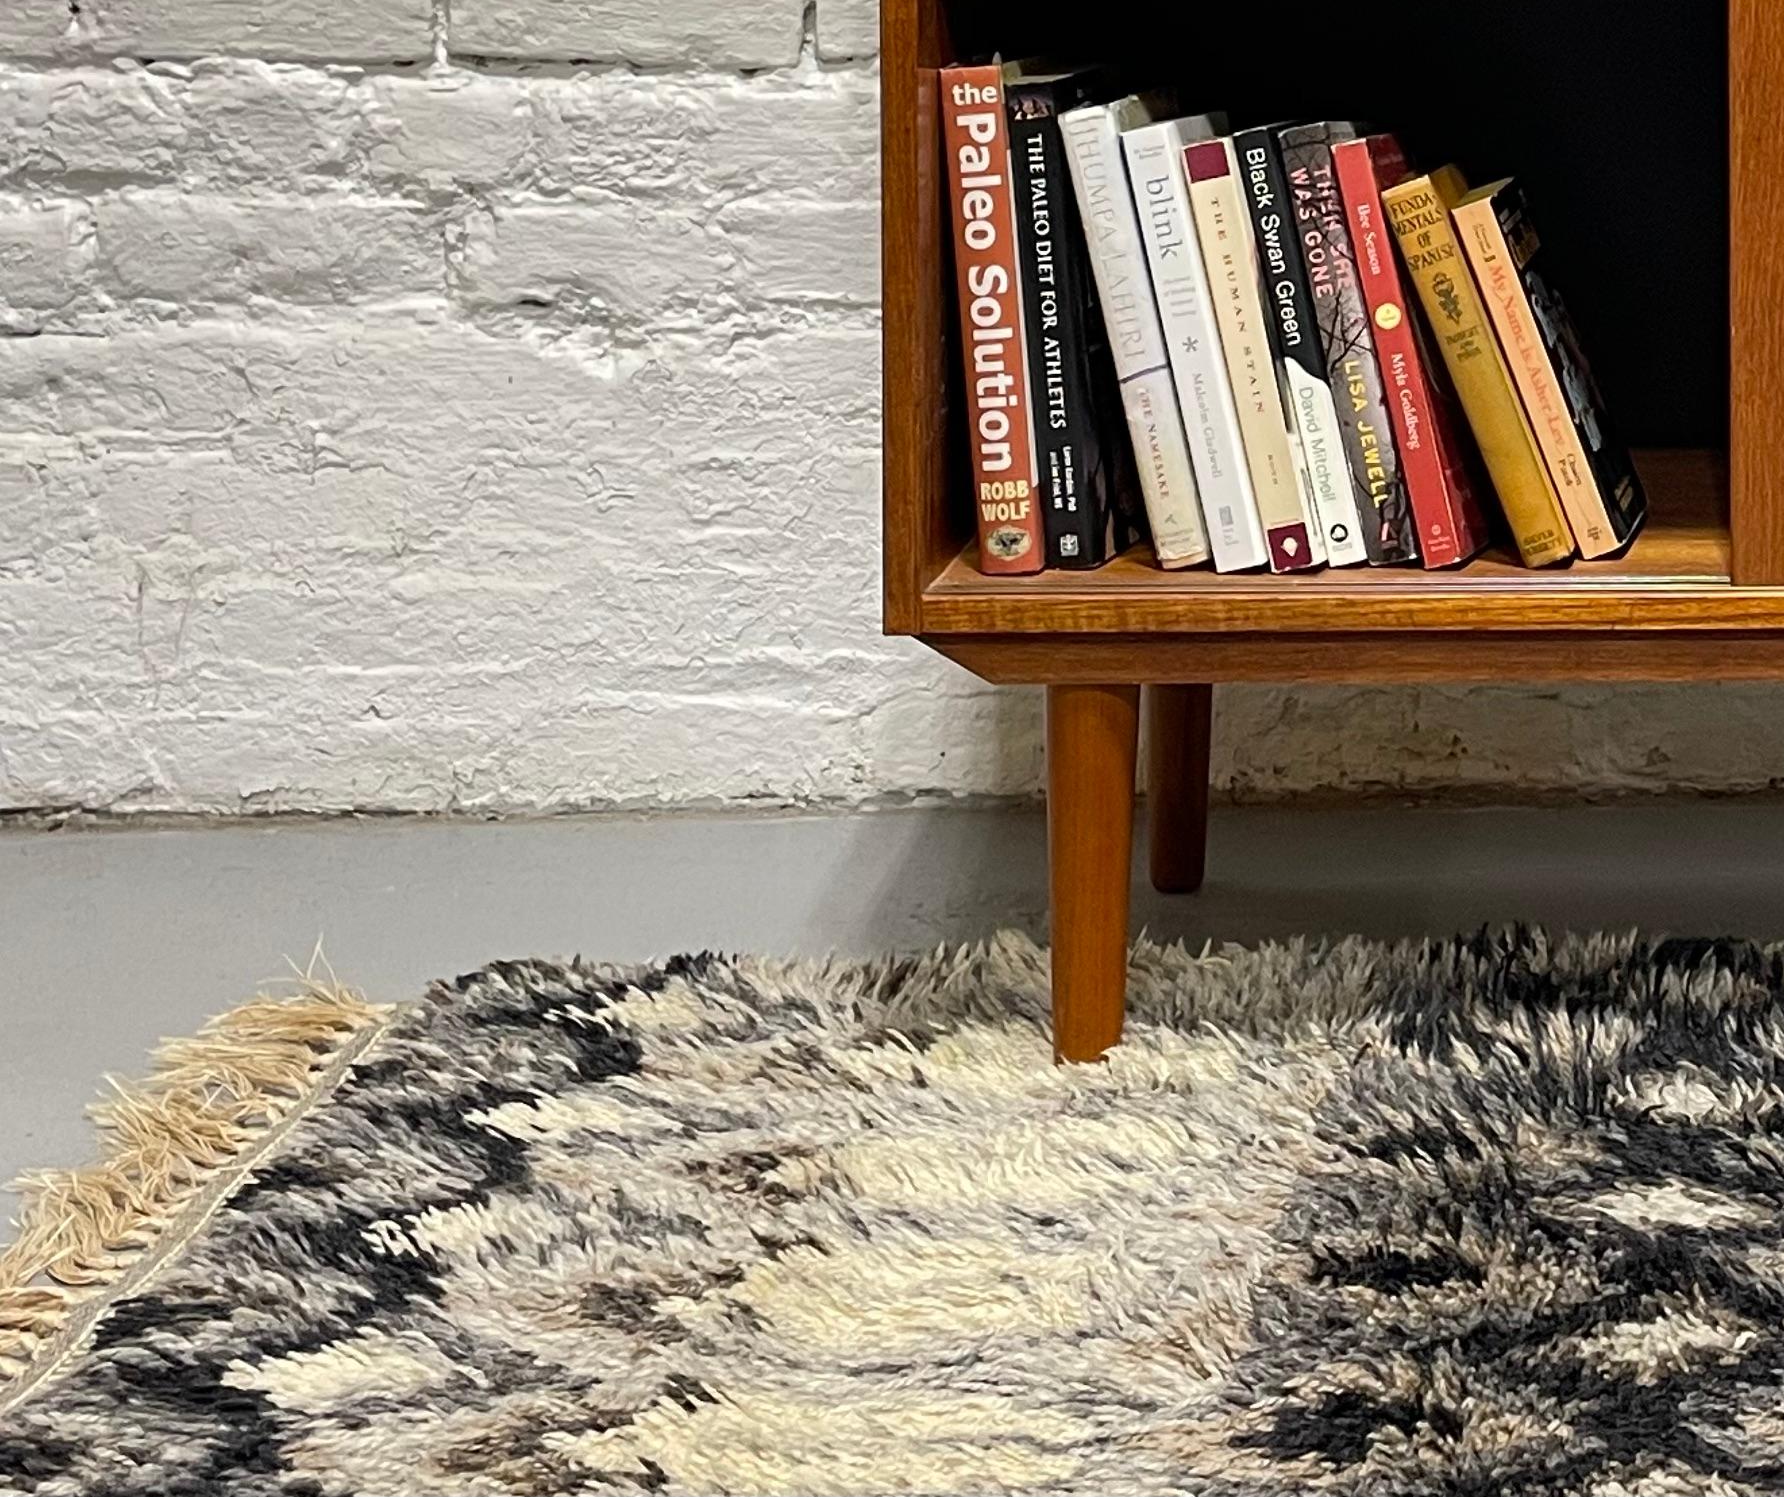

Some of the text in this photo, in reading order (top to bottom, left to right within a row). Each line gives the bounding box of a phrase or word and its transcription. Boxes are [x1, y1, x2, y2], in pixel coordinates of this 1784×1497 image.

[952, 83, 998, 105] the
[1068, 114, 1146, 358] JHUMPA LAHIRI
[1145, 176, 1183, 259] blink
[1245, 147, 1301, 346] Black Swan Green
[1290, 167, 1333, 297] WAS GONE
[1363, 233, 1382, 276] Season
[1417, 230, 1432, 247] OF
[955, 112, 1018, 473] Paleo Solution
[1026, 133, 1067, 429] THE PALEO DIET FOR ATHLETES
[1211, 197, 1264, 414] THE HUMAN STAIN
[1391, 353, 1421, 451] Myla Goldberg
[1489, 265, 1507, 294] My
[1503, 295, 1526, 345] Name
[1529, 366, 1553, 414] Asher
[1548, 415, 1566, 447] Lev
[1148, 423, 1170, 499] NAMESAKE
[1192, 372, 1224, 478] Malcolm Gladwell
[1299, 386, 1338, 502] David Mitchell
[1345, 360, 1388, 508] LISA JEWELL
[979, 481, 1029, 501] ROBB
[982, 502, 1031, 522] WOLF
